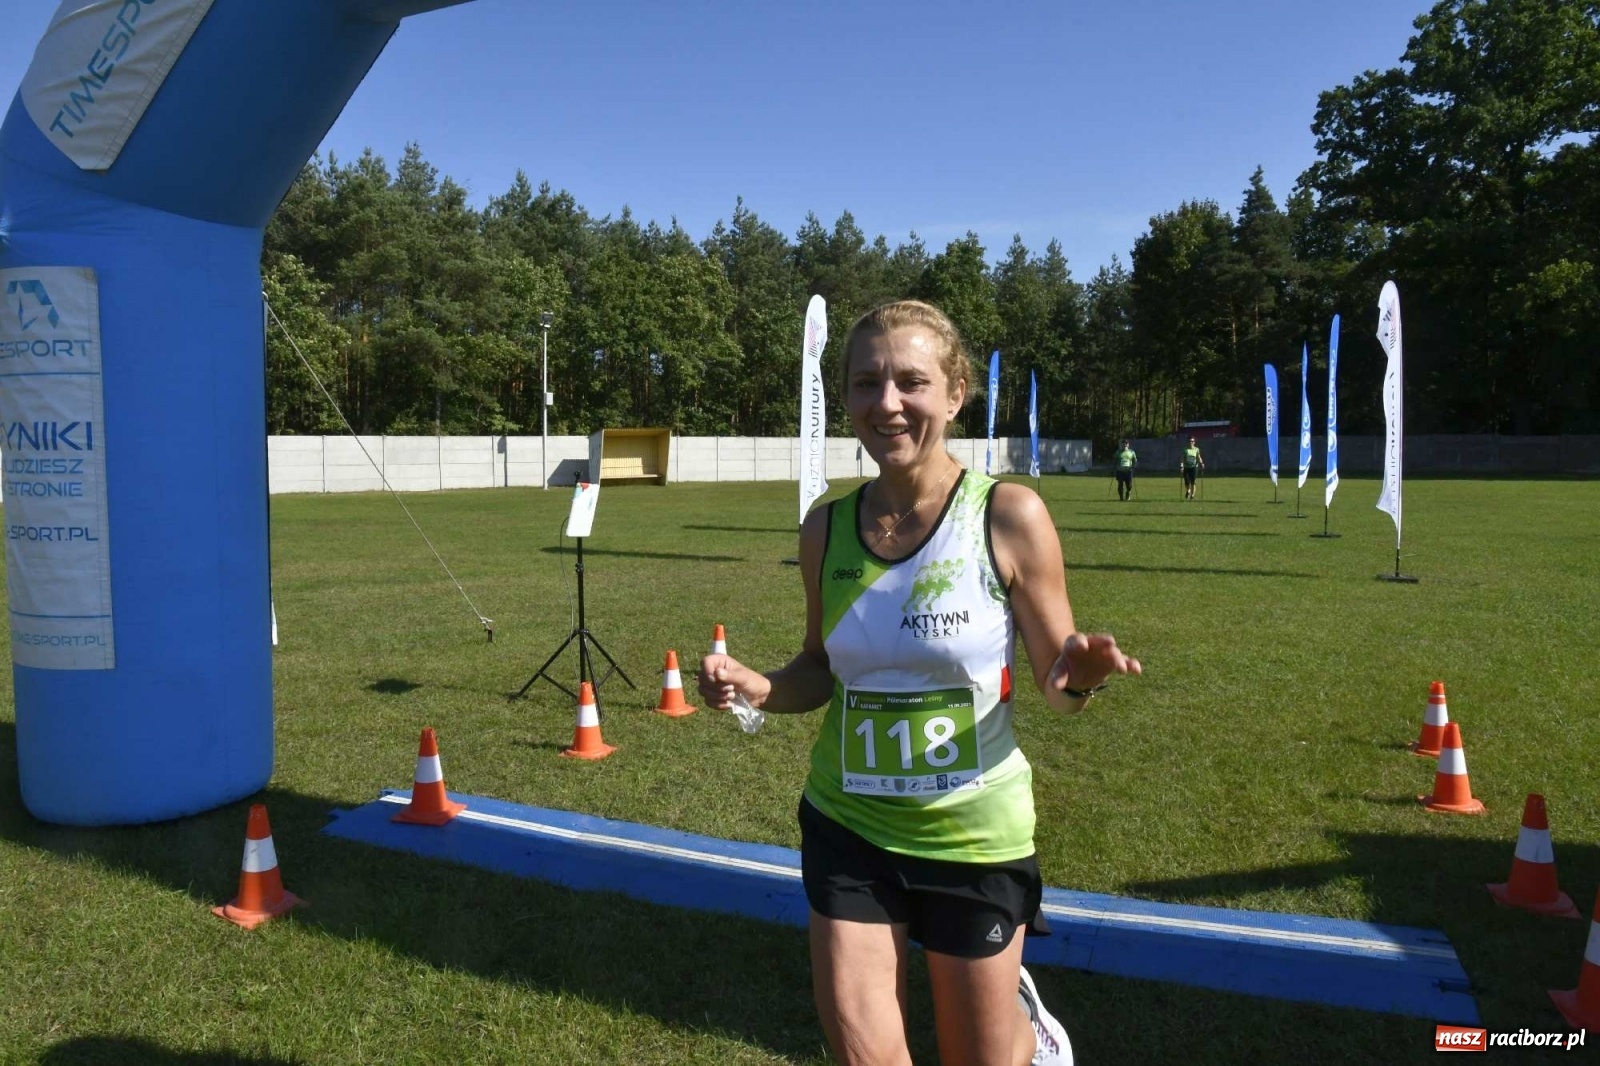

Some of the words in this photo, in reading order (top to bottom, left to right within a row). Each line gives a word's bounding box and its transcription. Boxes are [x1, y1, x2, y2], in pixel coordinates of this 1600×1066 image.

[50, 0, 151, 138] TIMESP
[0, 421, 93, 451] YNIKI
[5, 458, 84, 474] JDZIESZ
[832, 567, 863, 581] deep
[900, 611, 969, 629] AKTYWNI
[914, 626, 959, 638] LYSKI
[850, 695, 858, 708] V
[855, 716, 959, 769] 118
